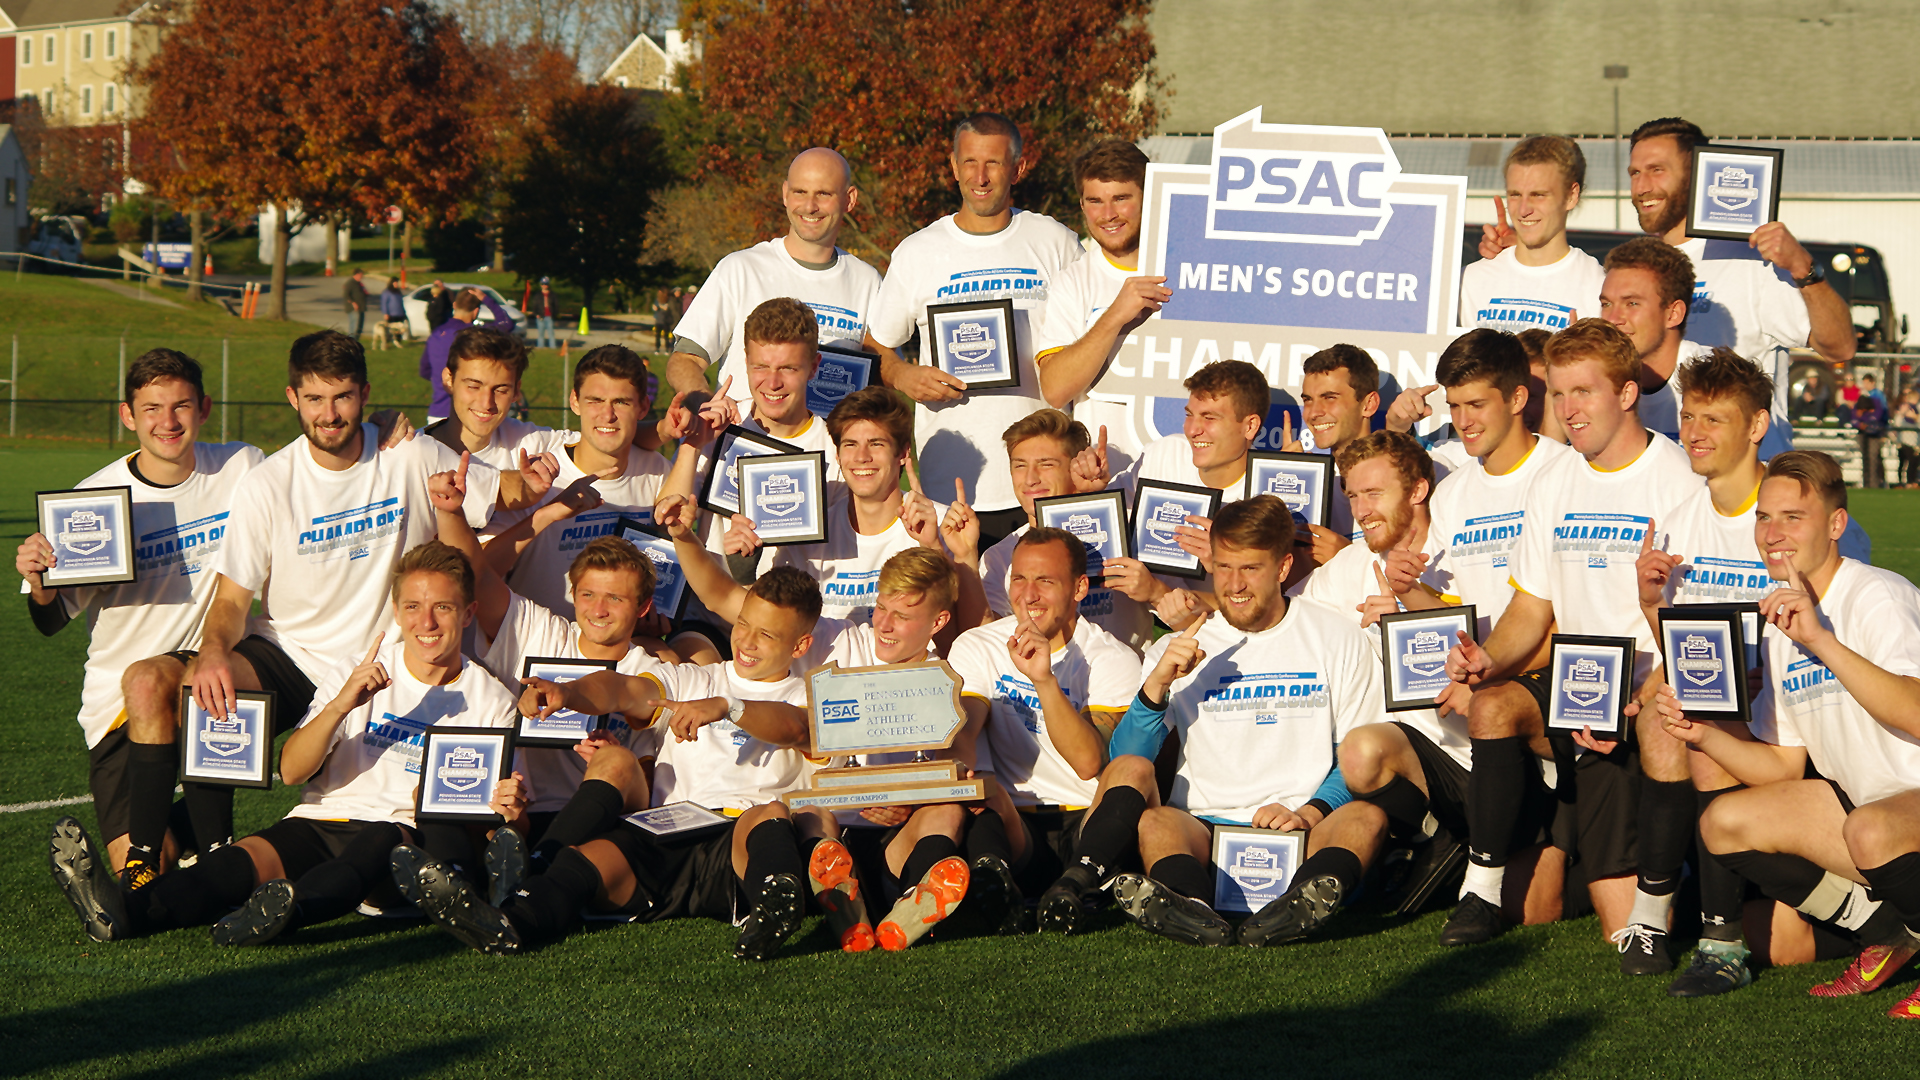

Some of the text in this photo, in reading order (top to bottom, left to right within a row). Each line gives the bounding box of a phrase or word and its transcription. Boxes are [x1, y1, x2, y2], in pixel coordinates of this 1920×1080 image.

[1216, 156, 1384, 209] PSAC
[1179, 262, 1419, 302] MEN'S SOCCER
[349, 547, 369, 557] PSAC
[1406, 654, 1447, 662] CHAMPION
[864, 687, 944, 700] PENNSYLVANIA
[822, 705, 860, 718] PSAC
[865, 703, 896, 712] STATE
[867, 714, 918, 726] ATHLETIC
[867, 725, 936, 737] CONFERENCE
[406, 762, 421, 770] PSA
[820, 797, 848, 805] SOCCER
[850, 794, 888, 802] CHAMPION
[1233, 868, 1279, 878] CHAMPIONS
